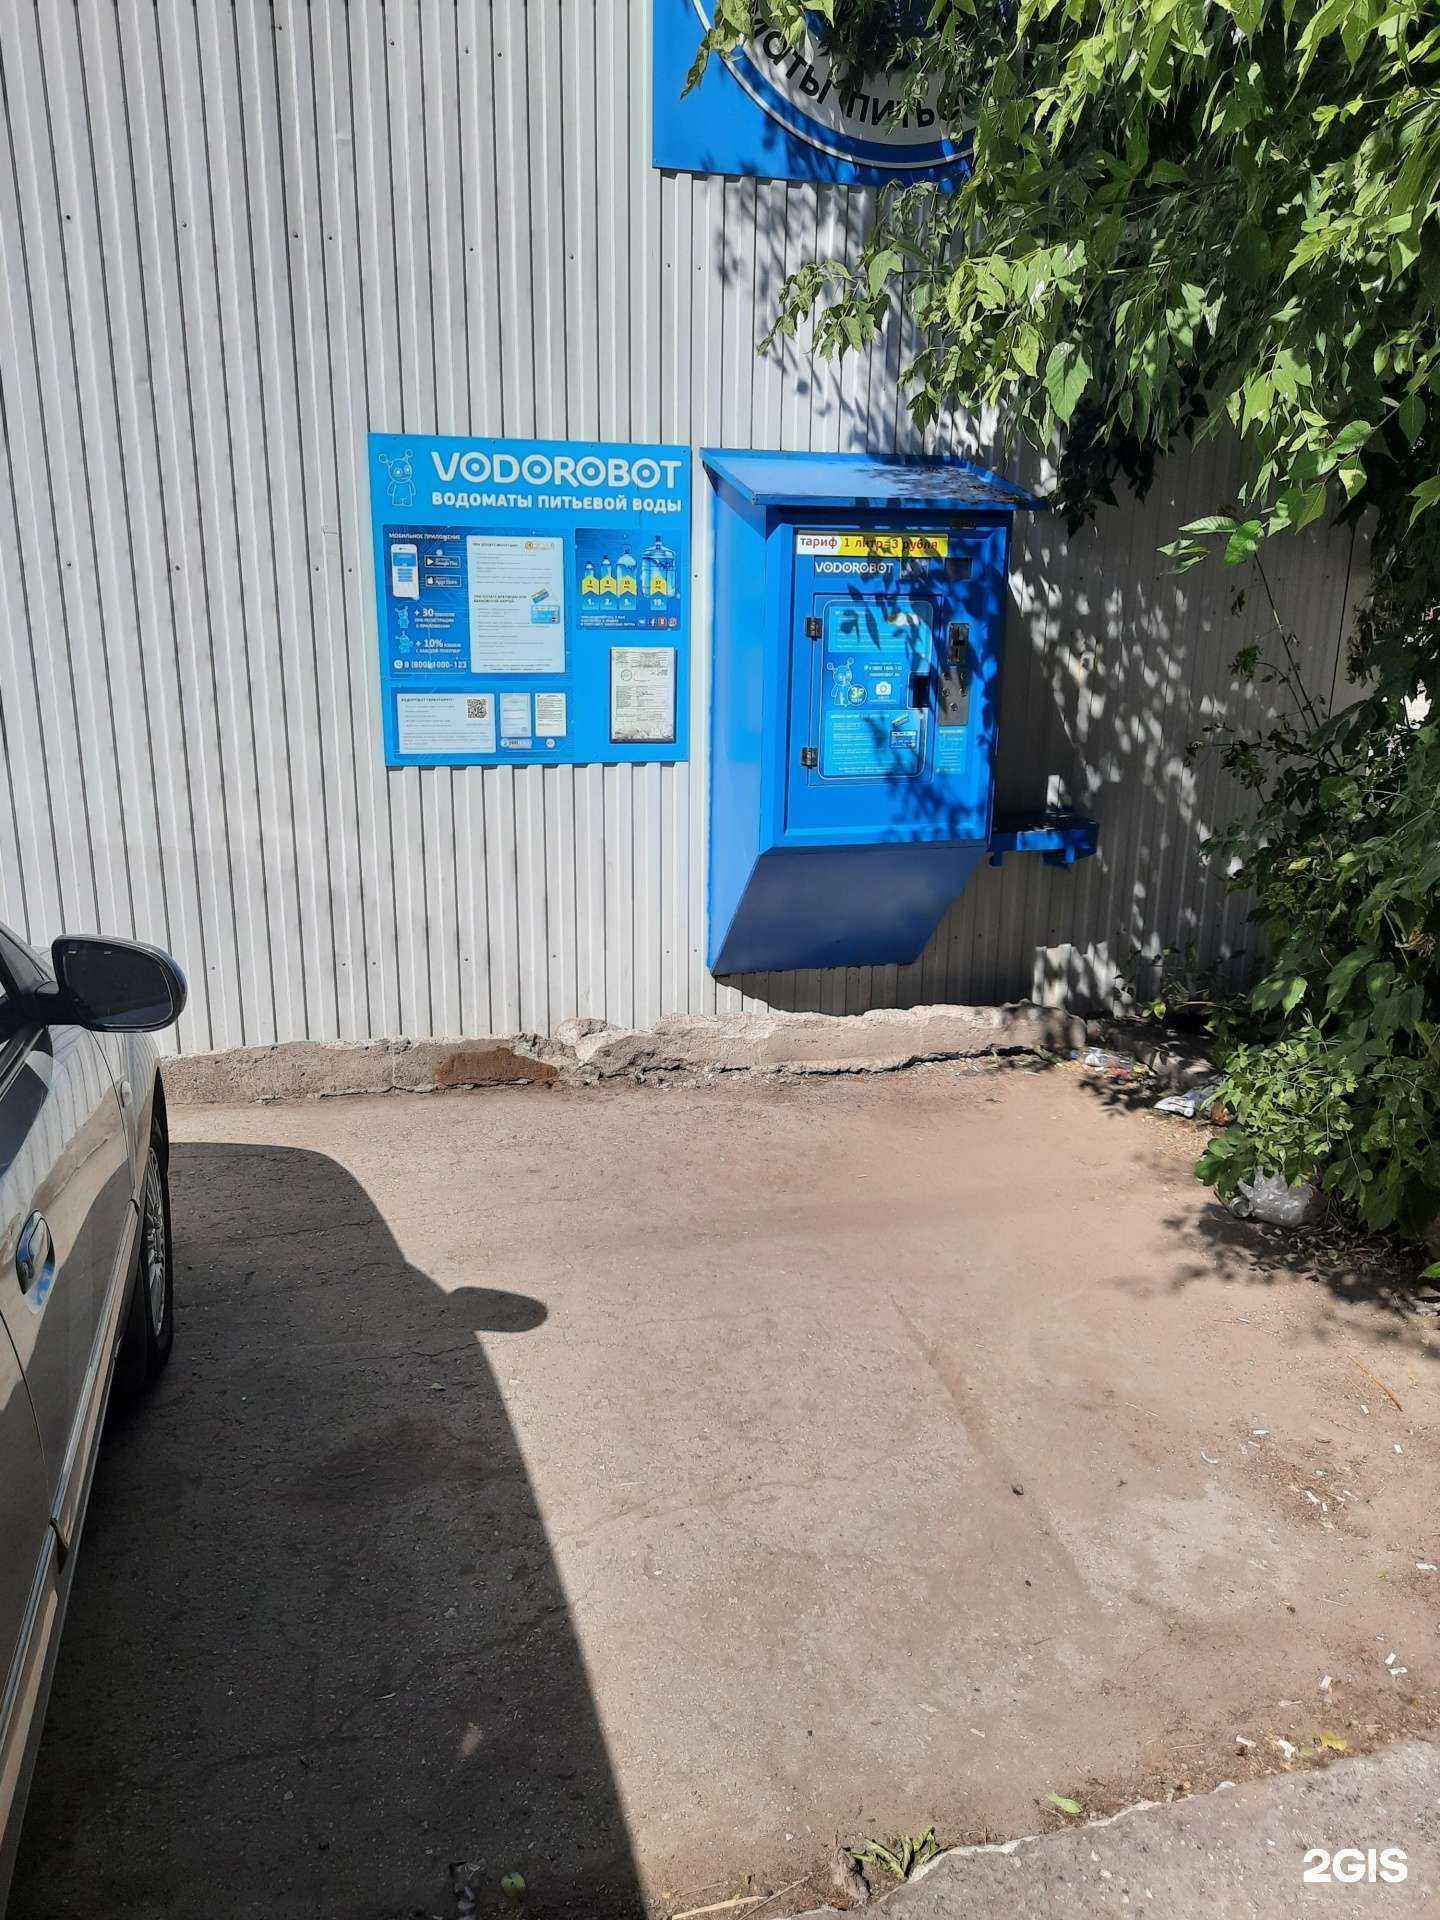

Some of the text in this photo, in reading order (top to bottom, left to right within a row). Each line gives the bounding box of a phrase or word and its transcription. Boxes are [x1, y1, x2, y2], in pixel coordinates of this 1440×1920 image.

[431, 452, 682, 489] VODOROBOT
[432, 492, 682, 514] ВОДОМАТЫ ПИТЬЕВОЙ ВОДЫ
[800, 537, 838, 549] тариф
[844, 538, 850, 547] 1
[815, 562, 894, 573] VODOROBOT
